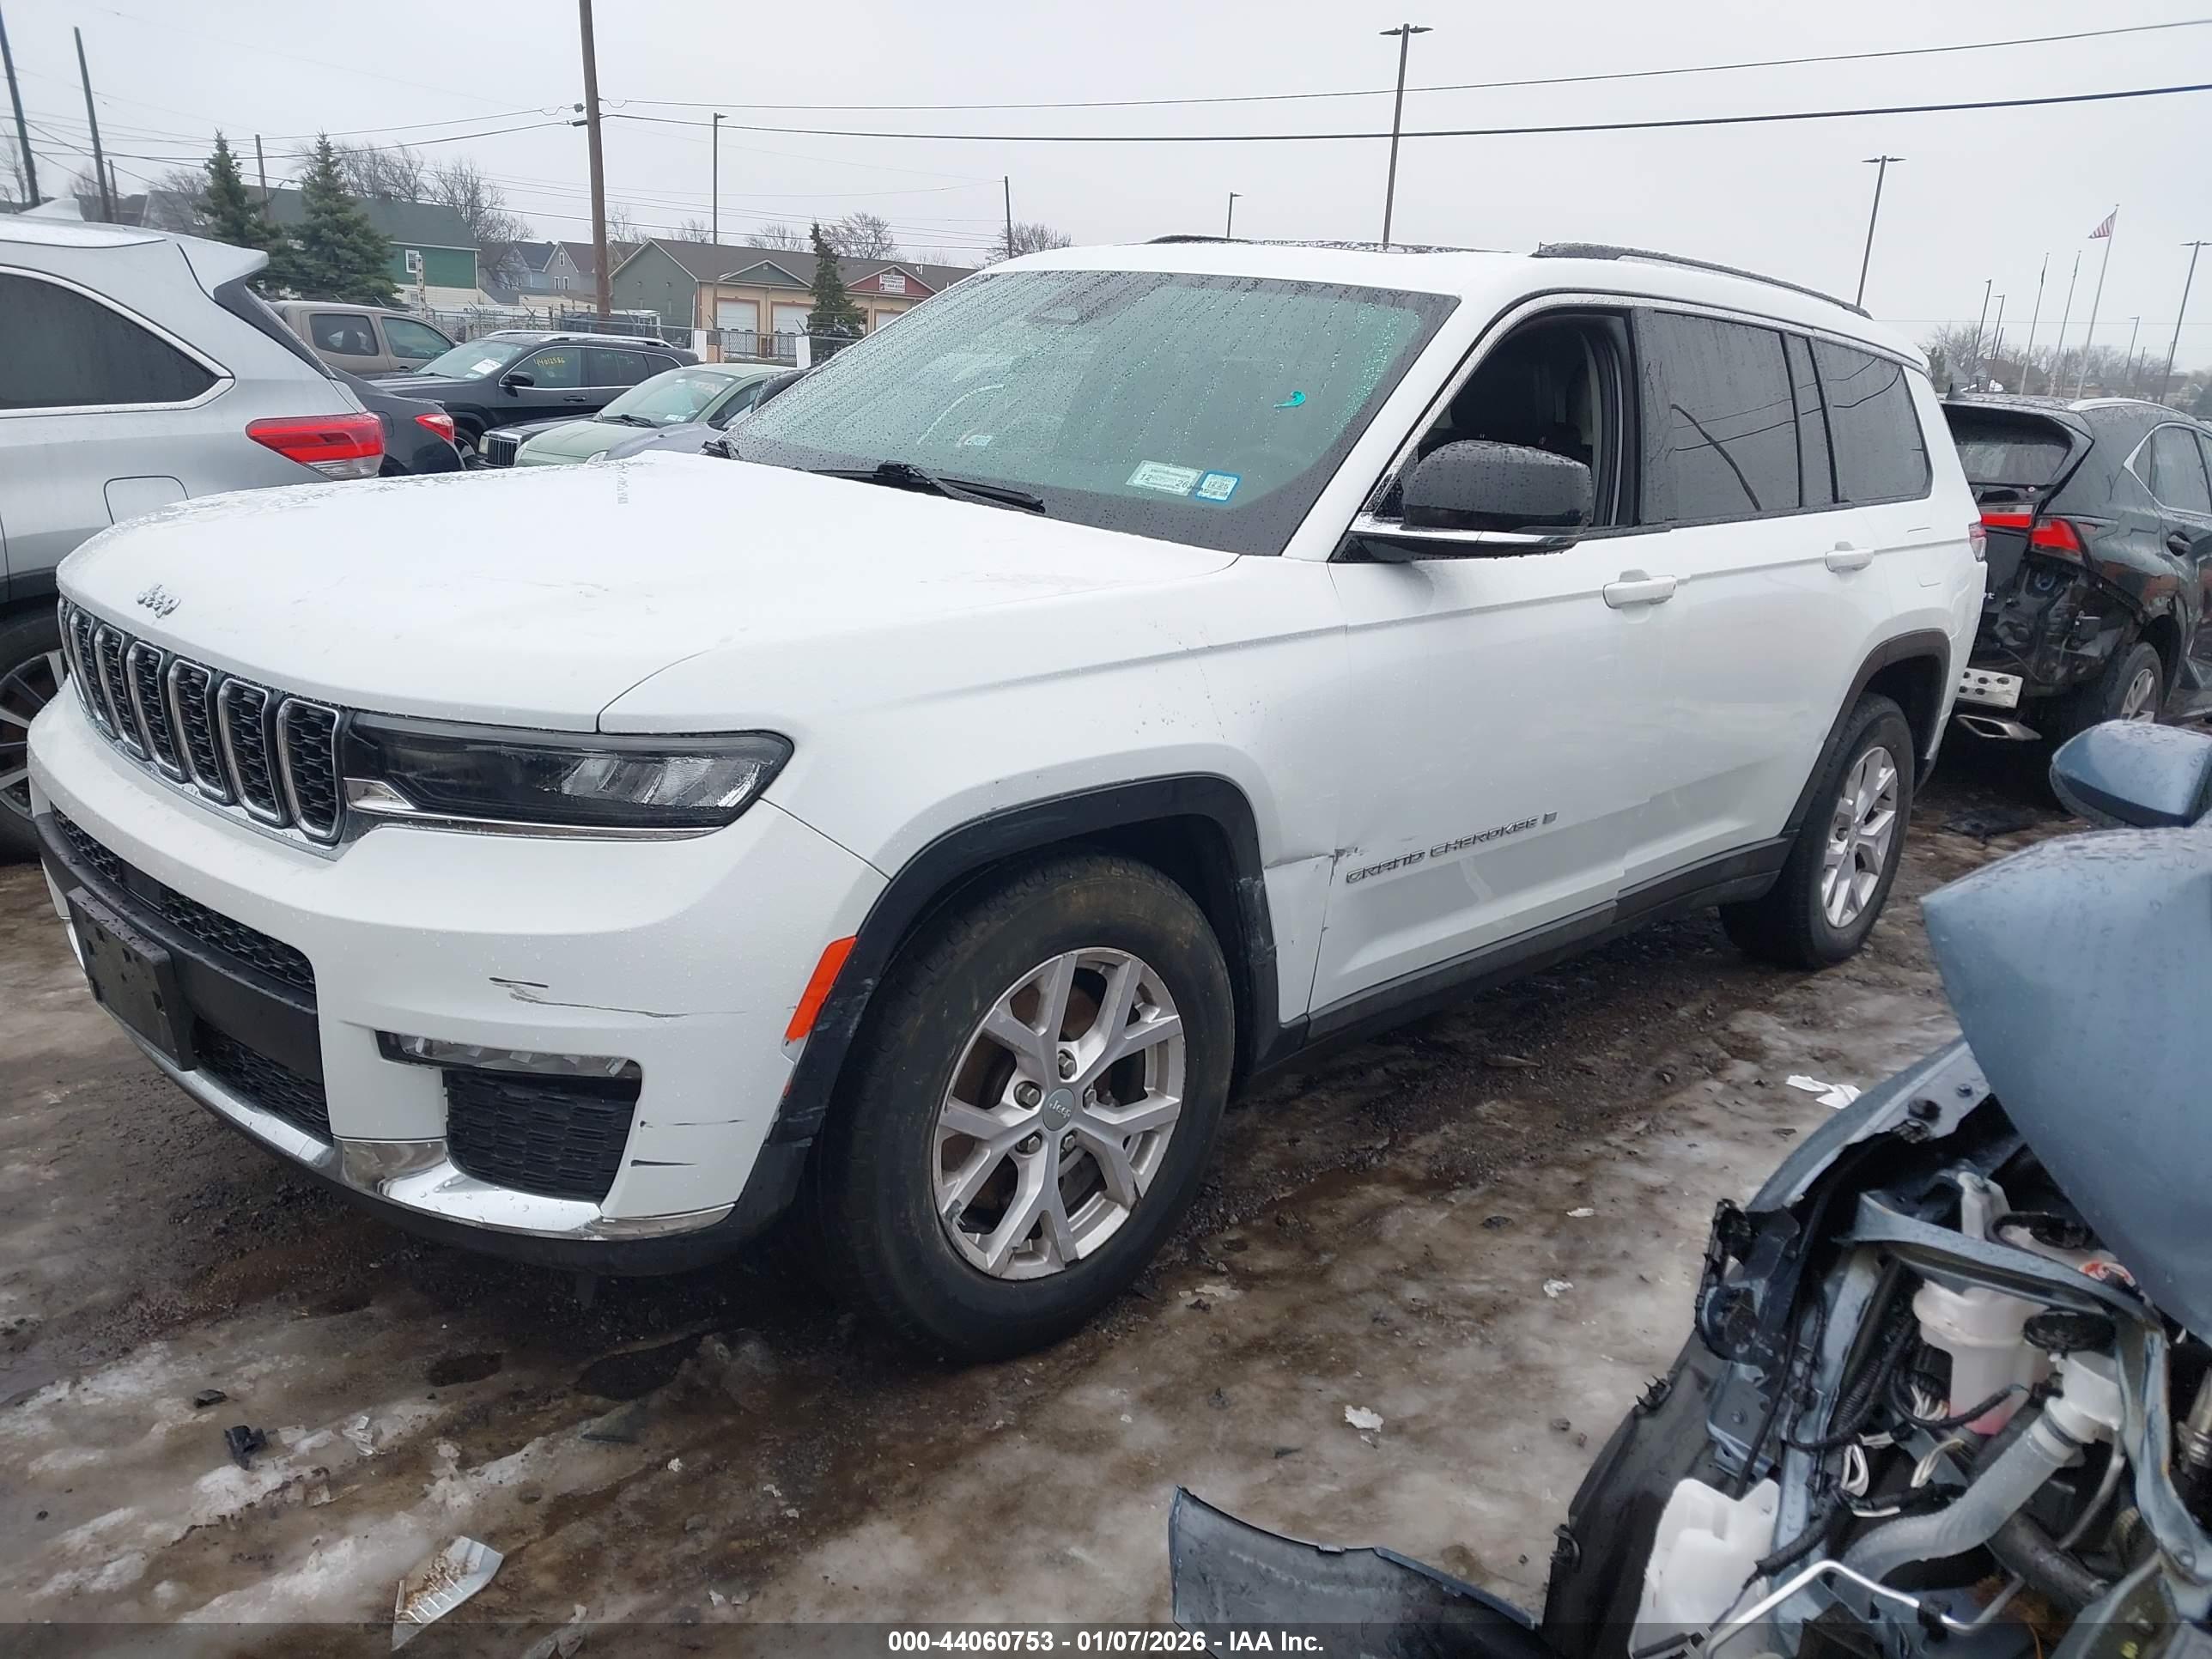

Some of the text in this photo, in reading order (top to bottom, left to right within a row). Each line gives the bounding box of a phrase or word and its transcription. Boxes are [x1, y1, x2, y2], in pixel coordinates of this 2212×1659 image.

[136, 584, 181, 618] Jeep
[1346, 816, 1540, 884] GRAND CHEROKEE
[1048, 1099, 1072, 1119] Jeep
